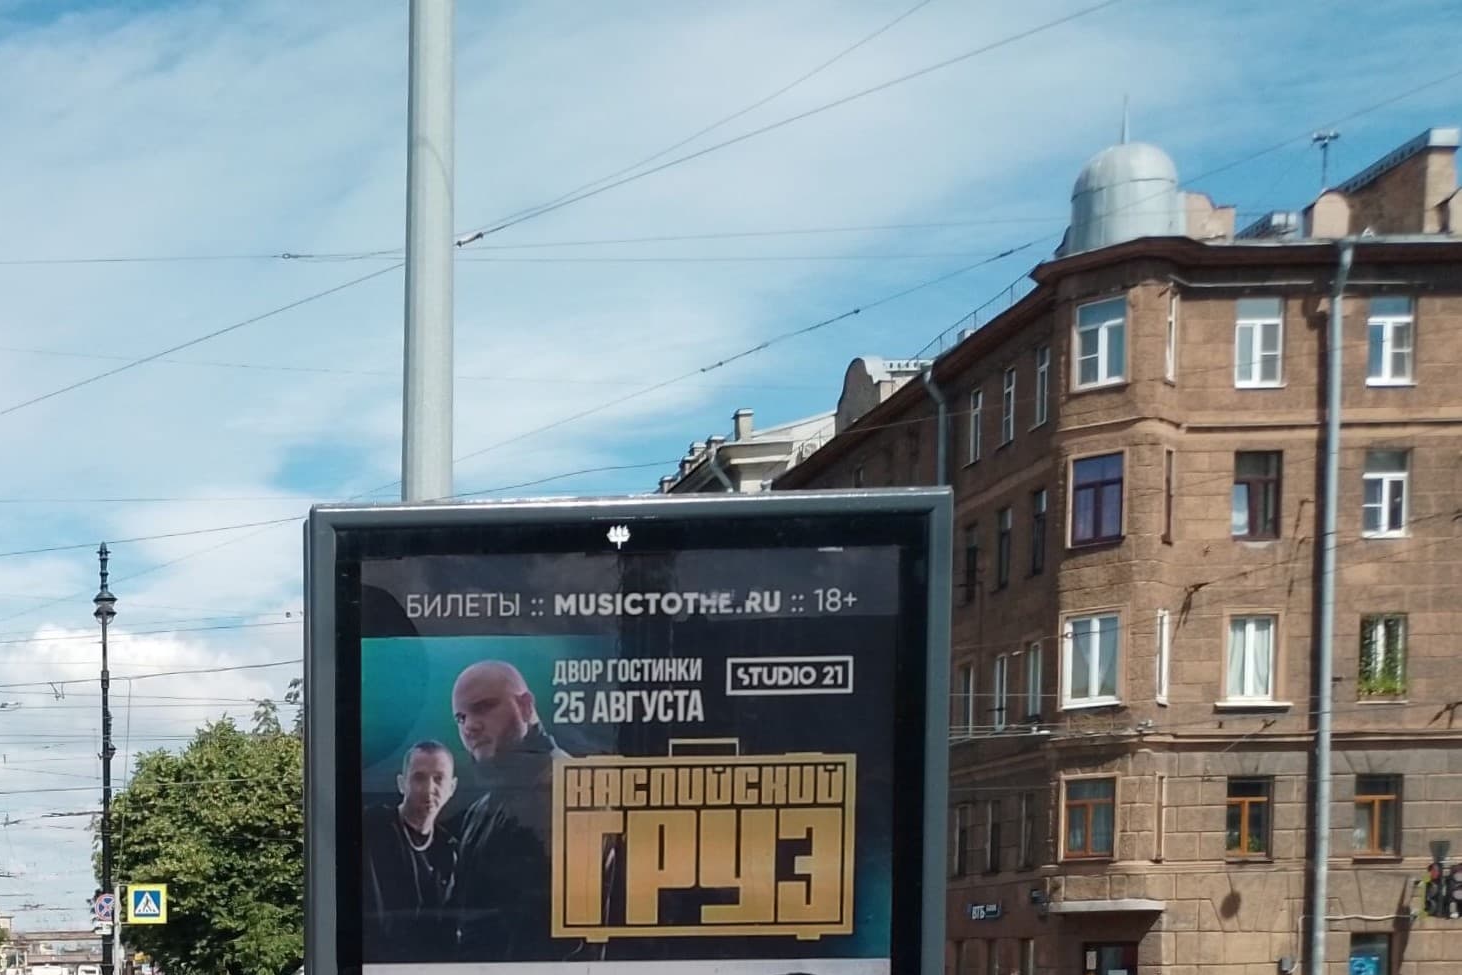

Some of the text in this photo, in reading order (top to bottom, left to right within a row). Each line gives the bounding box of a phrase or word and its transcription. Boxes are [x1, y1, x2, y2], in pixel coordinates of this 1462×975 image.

[406, 593, 520, 618] БИЛЕТЫ
[554, 590, 781, 616] MUSICTOTHE.RU
[813, 588, 857, 613] 18+
[552, 658, 703, 685] ДВОР ГОСТИНКИ
[737, 665, 844, 687] STUDIO 21
[553, 689, 706, 724] 25 АВГУСТА
[565, 763, 844, 807] КАСПИЙСКИЙ
[565, 807, 844, 925] ГРУЗ
